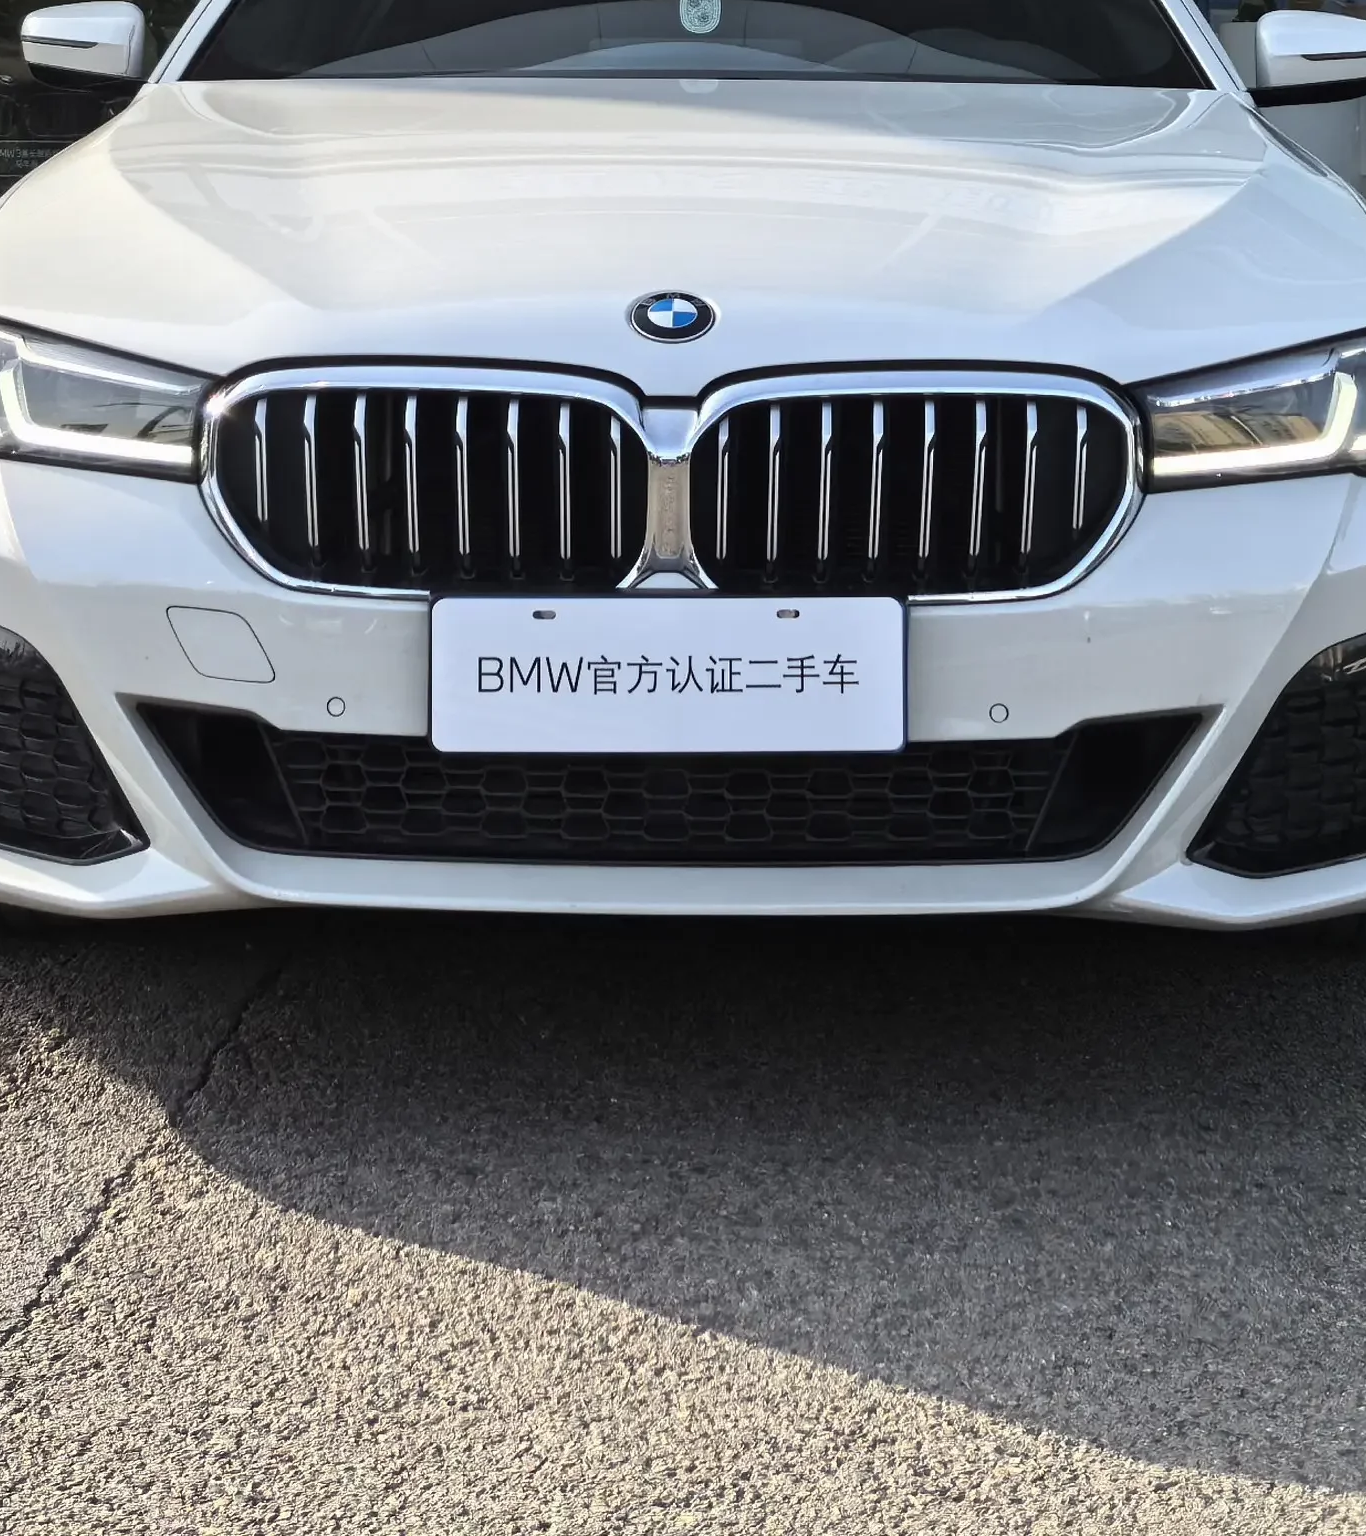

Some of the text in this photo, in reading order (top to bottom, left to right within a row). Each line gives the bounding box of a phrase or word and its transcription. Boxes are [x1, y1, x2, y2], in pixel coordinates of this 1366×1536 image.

[475, 652, 861, 697] BMW官方认证二手车
